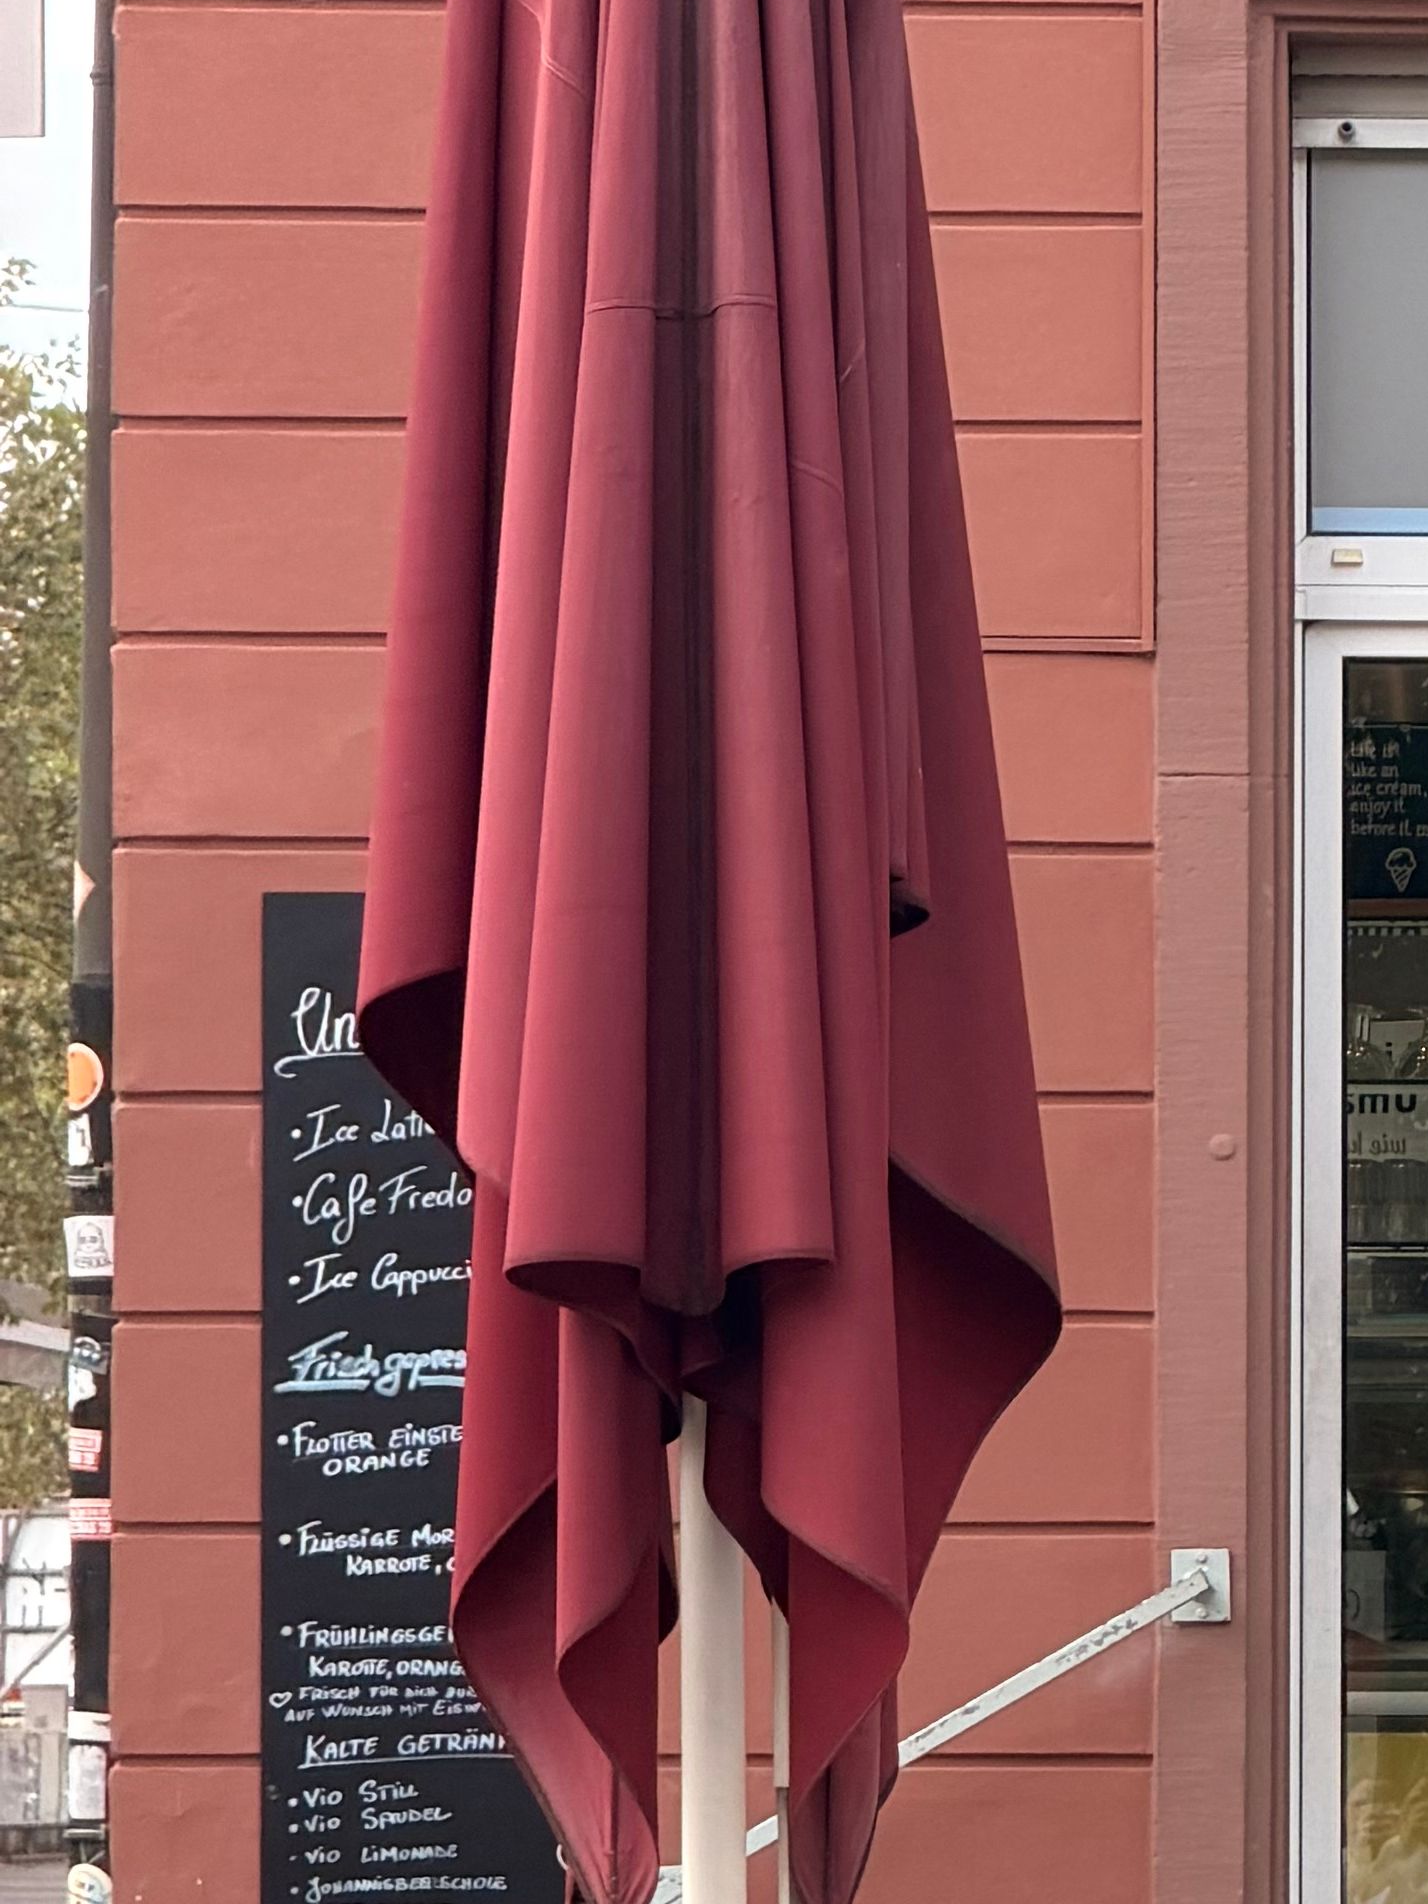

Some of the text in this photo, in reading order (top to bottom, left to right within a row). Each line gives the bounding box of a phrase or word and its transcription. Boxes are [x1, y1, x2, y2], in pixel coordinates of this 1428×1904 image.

[1350, 799, 1391, 818] enjoy
[1351, 819, 1396, 836] before
[293, 1104, 360, 1162] Ice
[296, 1252, 359, 1304] Ice
[321, 1447, 432, 1477] ORANGE
[304, 1734, 380, 1768] KALTE
